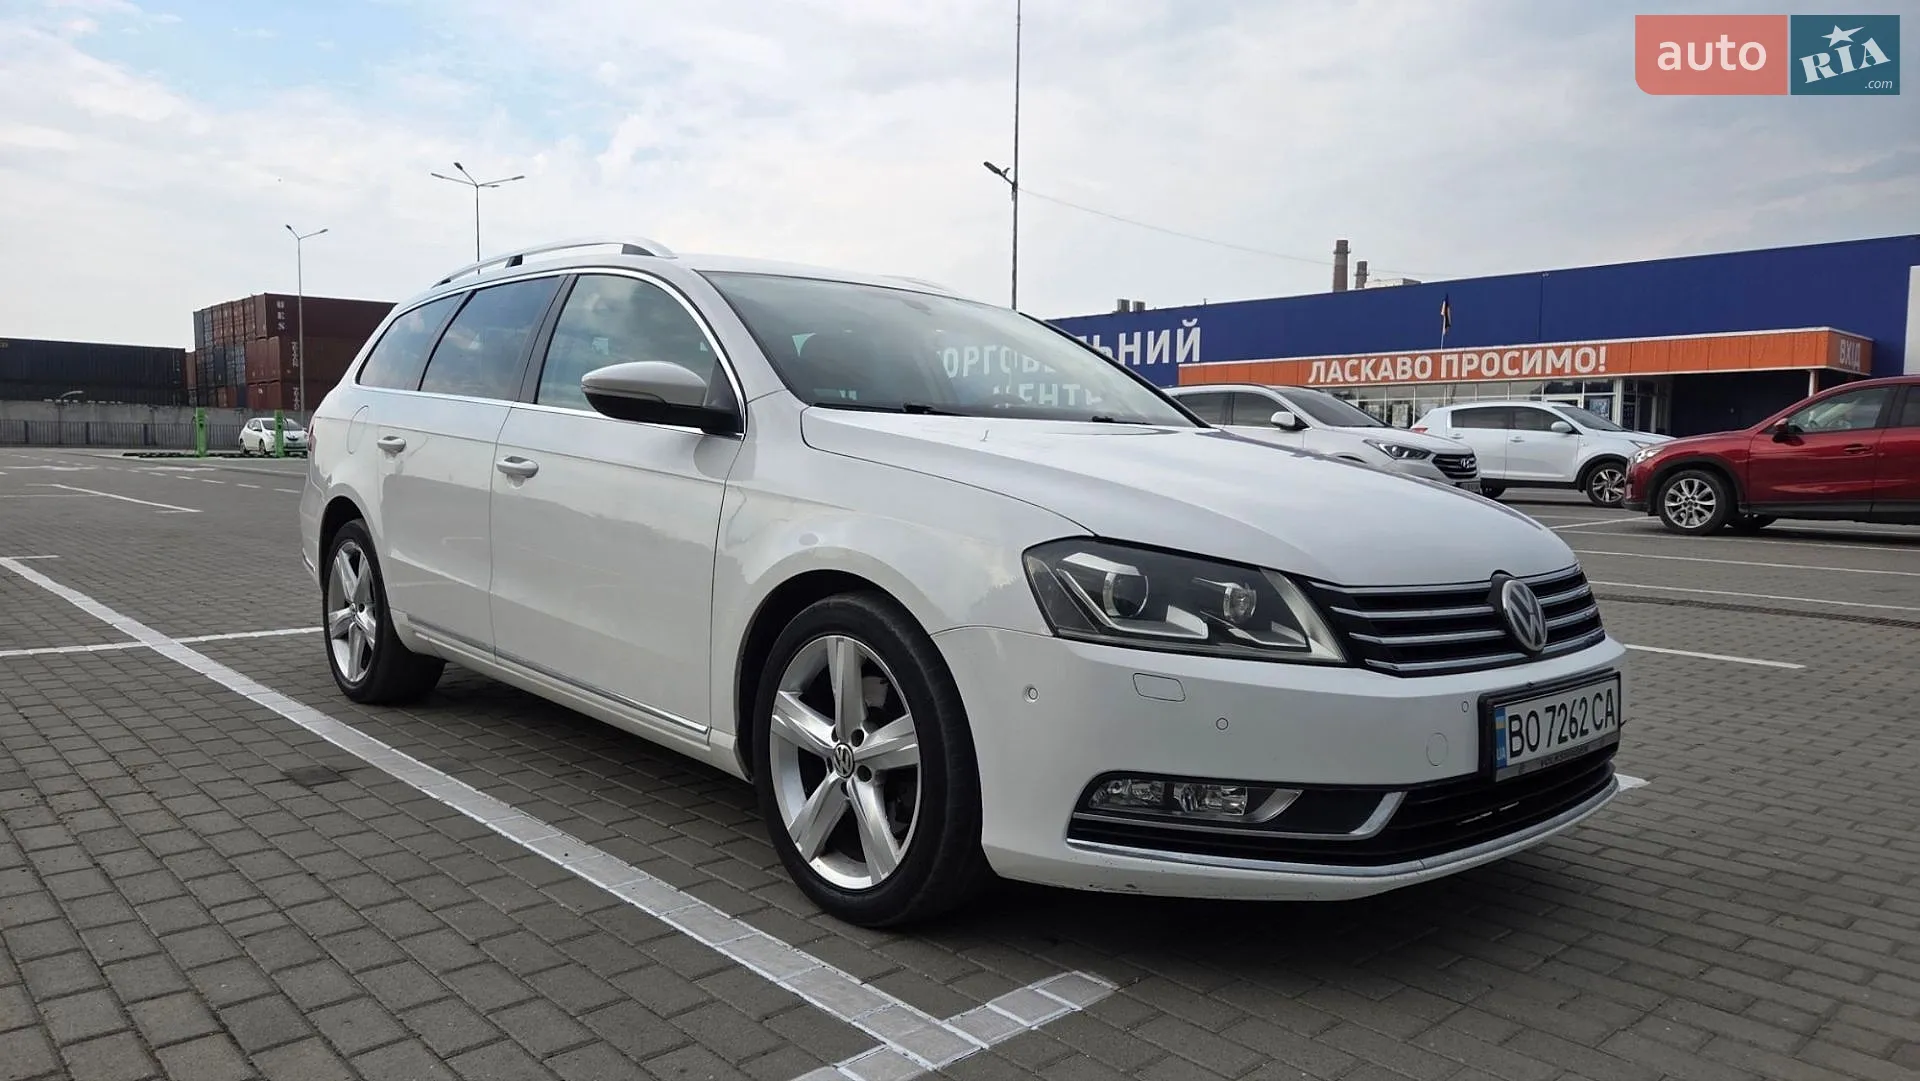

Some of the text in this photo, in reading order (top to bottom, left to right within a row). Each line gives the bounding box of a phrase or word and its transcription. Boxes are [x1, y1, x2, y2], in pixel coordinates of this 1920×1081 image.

[1308, 346, 1607, 384] ЛАСКАВО ПРОСИМО!
[1509, 710, 1540, 758] BO
[1545, 696, 1590, 748] 7262
[1592, 688, 1616, 731] CA
